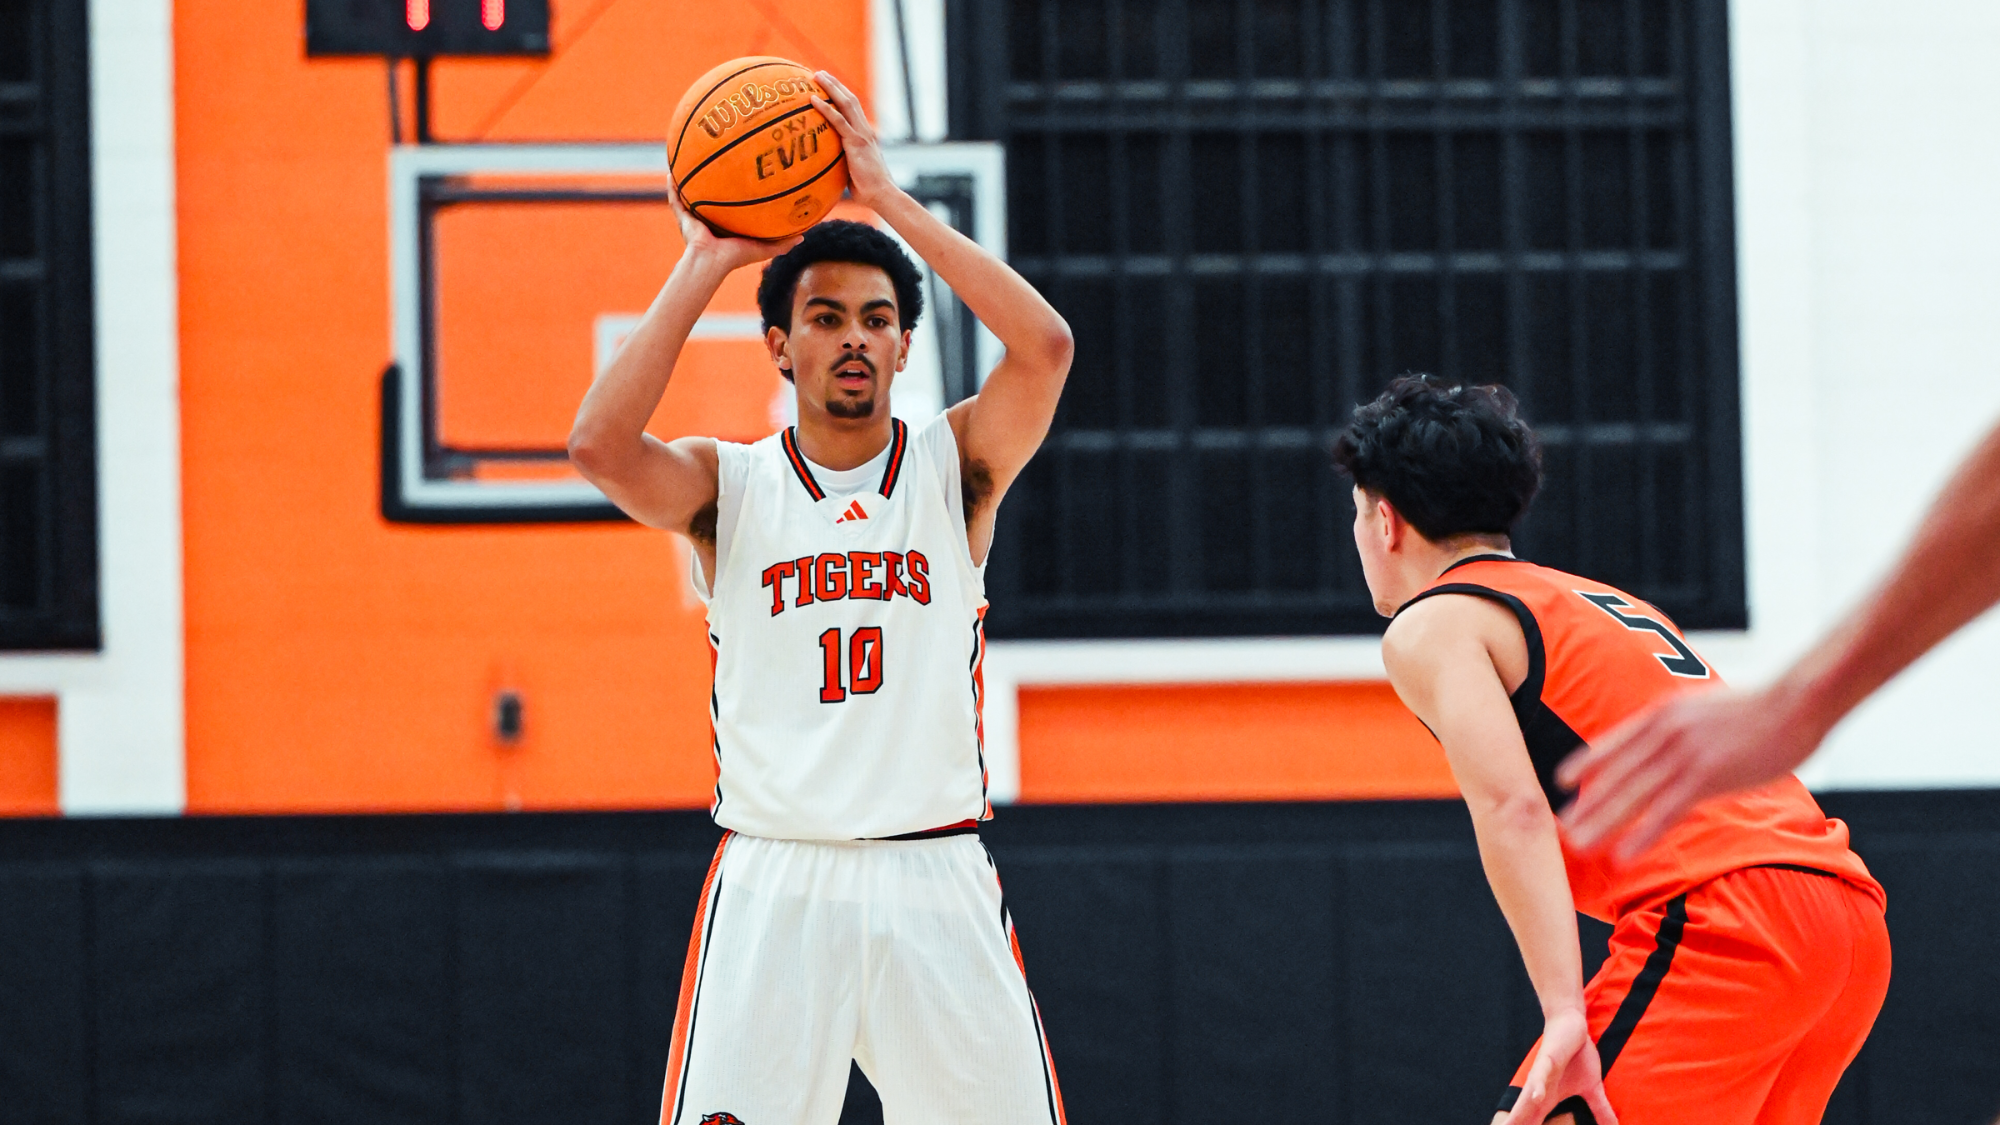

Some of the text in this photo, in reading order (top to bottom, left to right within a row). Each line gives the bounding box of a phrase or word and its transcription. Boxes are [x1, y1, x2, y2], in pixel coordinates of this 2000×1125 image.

[697, 76, 818, 139] Wilson
[772, 115, 806, 142] OXY
[762, 550, 931, 617] TIGERS
[819, 626, 884, 704] 10
[1571, 589, 1710, 679] 5
